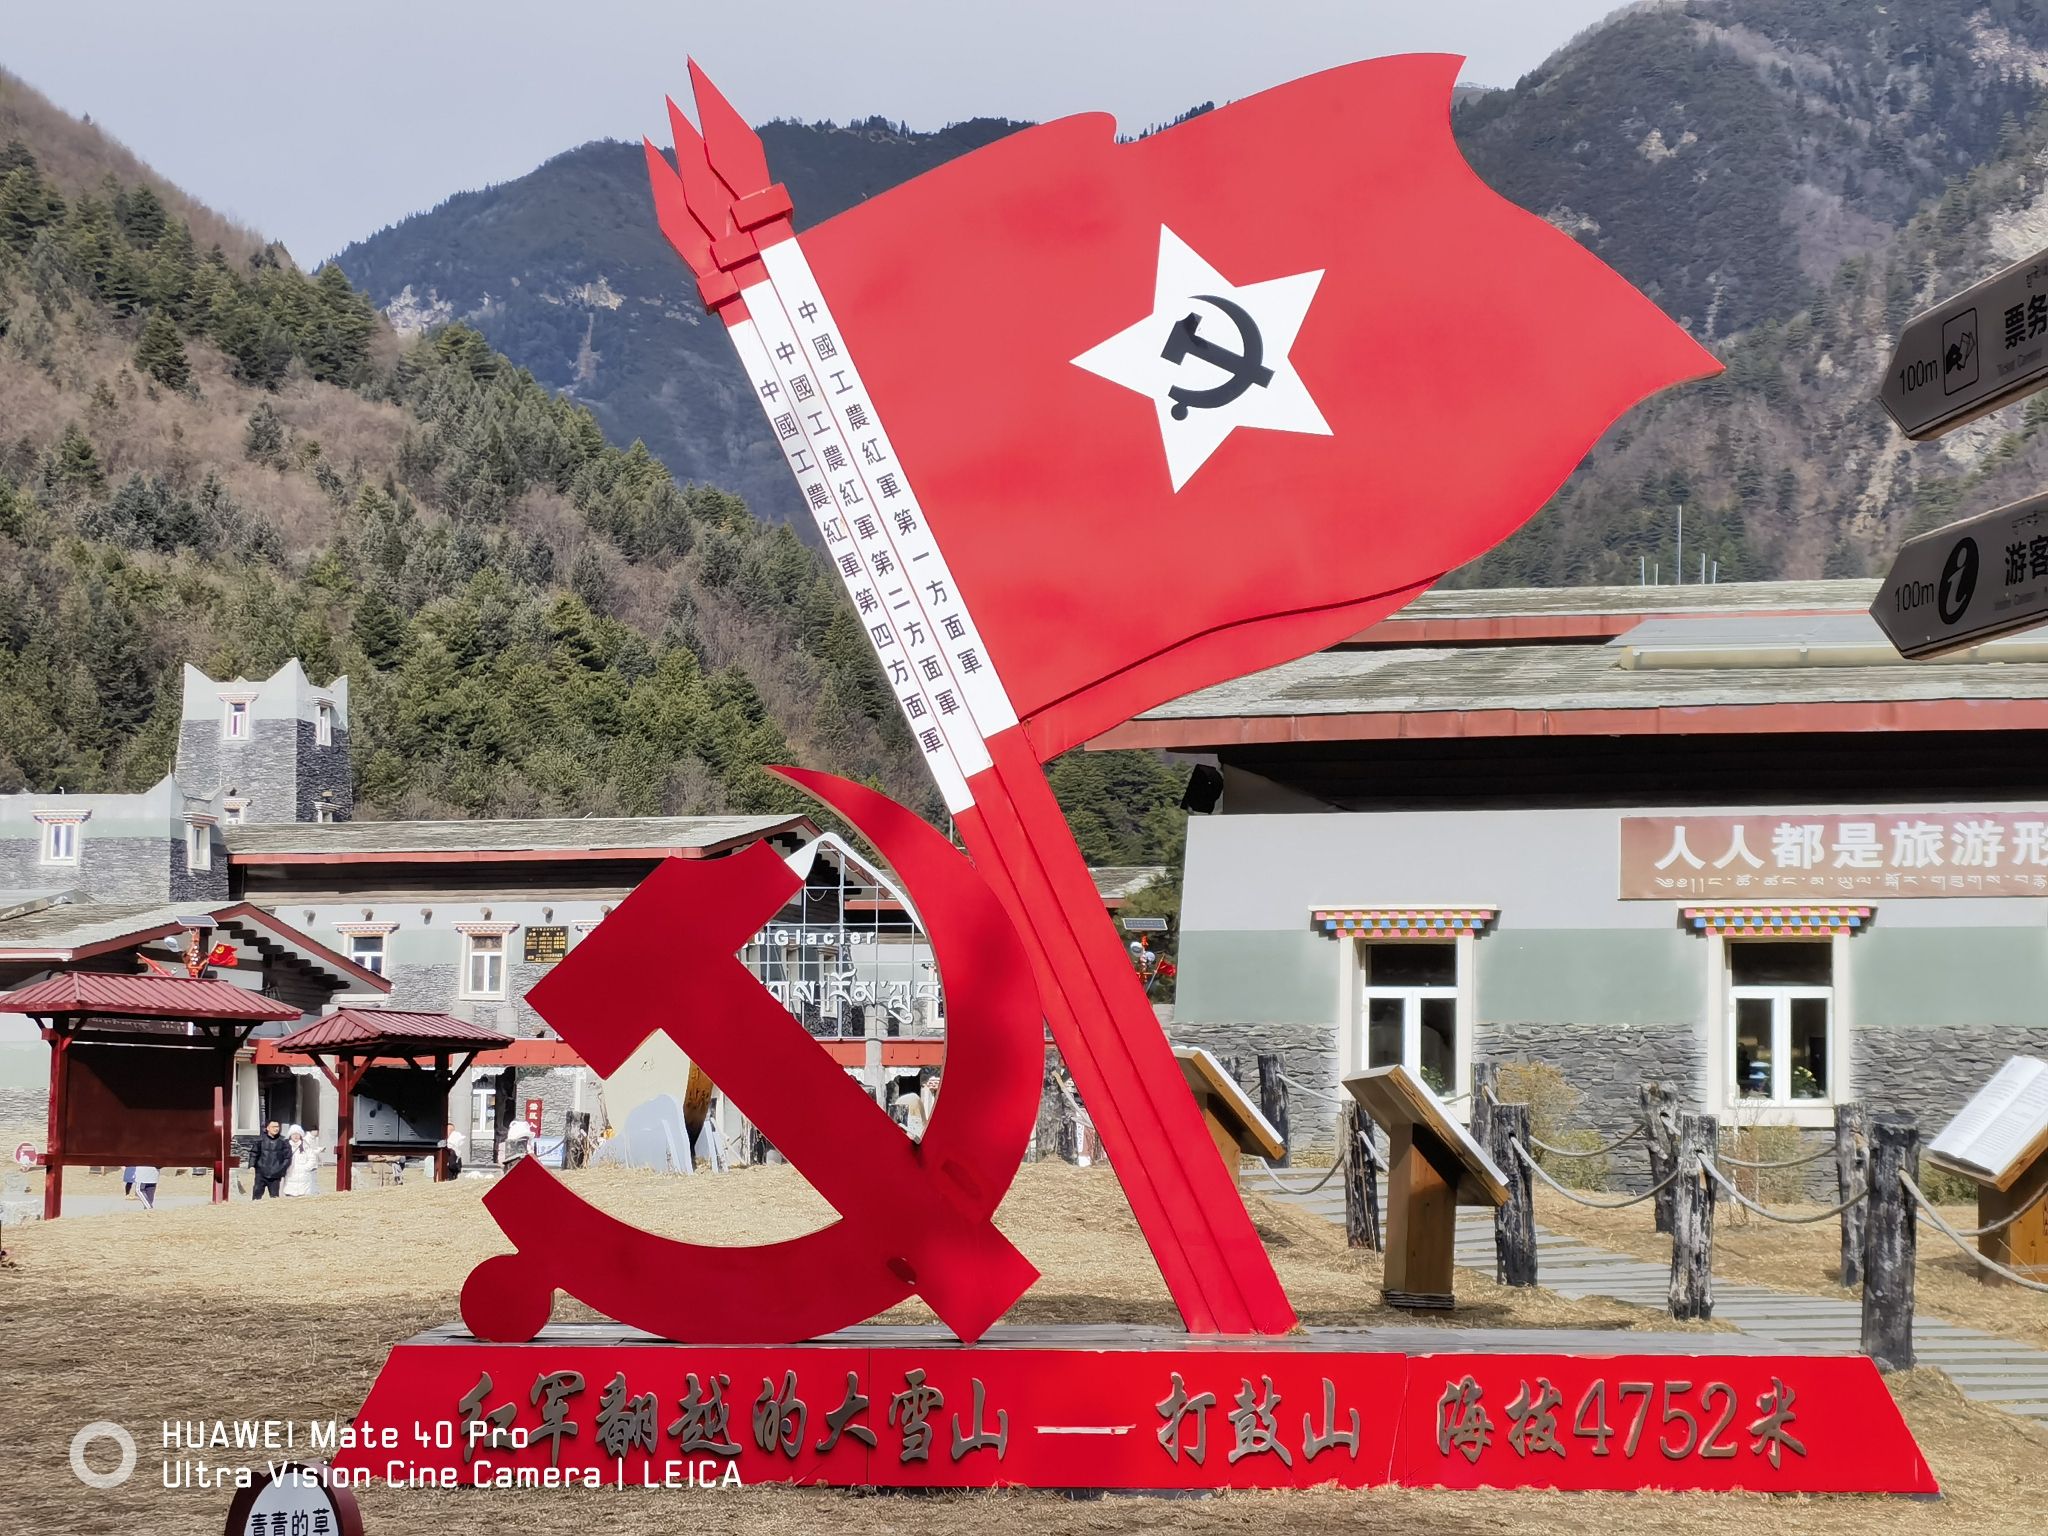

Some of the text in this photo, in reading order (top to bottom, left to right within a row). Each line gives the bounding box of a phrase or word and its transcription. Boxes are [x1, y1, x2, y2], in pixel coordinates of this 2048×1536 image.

[1900, 360, 1938, 396] 100m
[798, 300, 983, 675] 中國工農紅軍第一方面軍
[775, 341, 960, 716] 中國工農紅軍第二方面軍
[759, 379, 944, 754] 中國工農紅軍第四方面軍
[1895, 580, 1935, 613] 100m
[1654, 820, 2048, 870] 人人都是旅游形
[774, 929, 876, 946] Glacier
[1436, 1374, 1808, 1470] 海拔4752米
